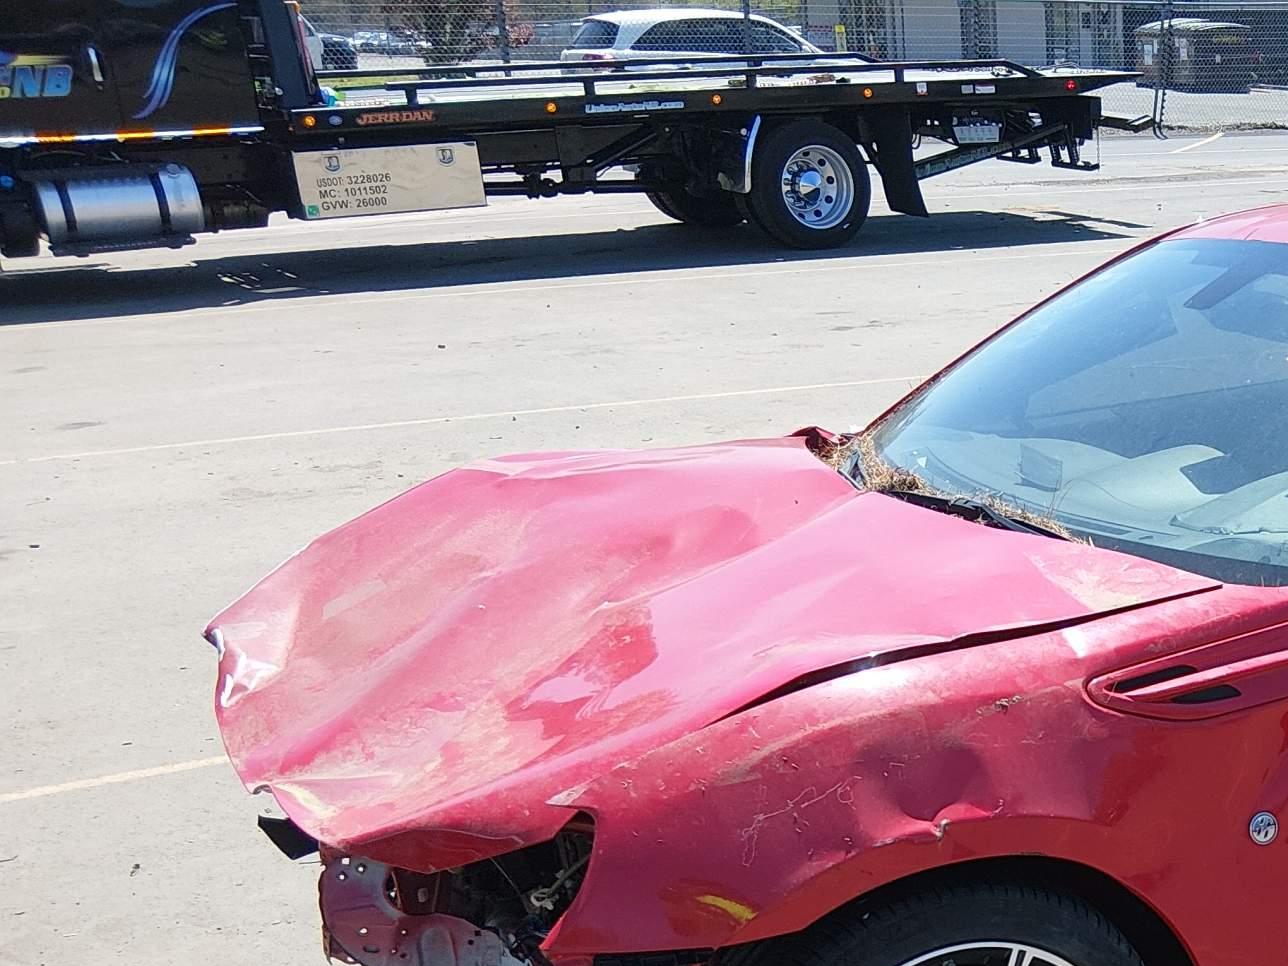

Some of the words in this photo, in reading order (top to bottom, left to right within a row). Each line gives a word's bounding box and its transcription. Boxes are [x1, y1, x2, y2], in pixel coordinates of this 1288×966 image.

[316, 177, 344, 188] USDOT:
[346, 173, 391, 185] 3228026
[319, 189, 341, 199] MC:
[344, 184, 388, 198] 1011502
[321, 199, 352, 211] GVW:
[355, 196, 388, 208] 26000
